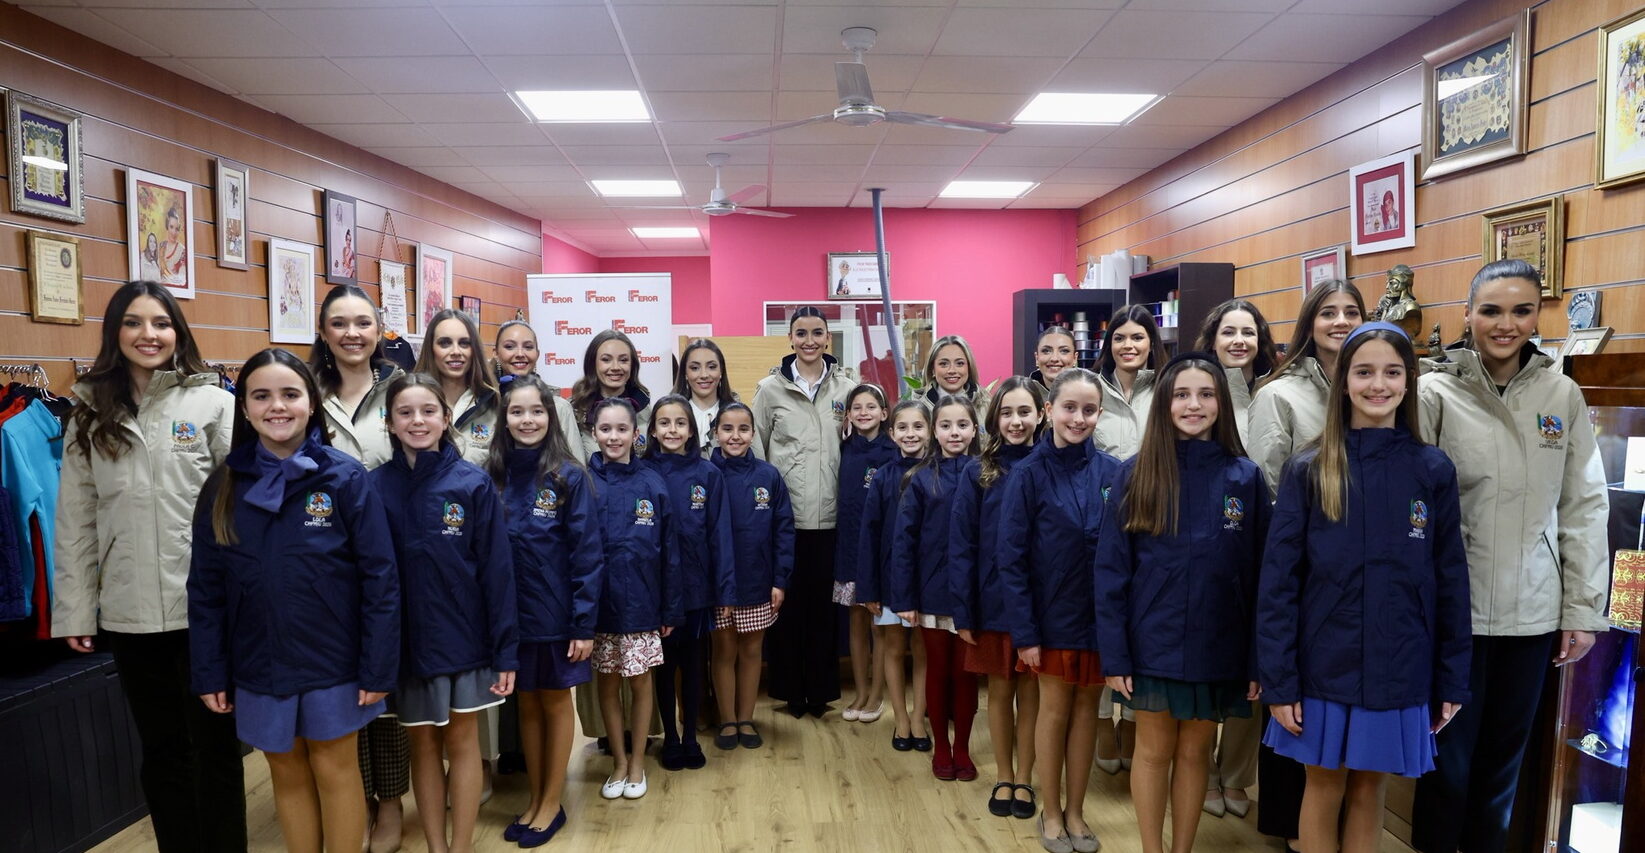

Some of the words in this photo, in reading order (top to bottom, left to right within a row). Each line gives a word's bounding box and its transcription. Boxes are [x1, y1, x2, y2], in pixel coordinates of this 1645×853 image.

[541, 290, 573, 303] FEROR
[585, 290, 616, 303] FEROR
[628, 289, 659, 302] FEROR
[555, 320, 592, 335] FEROR
[612, 319, 648, 334] FEROR
[545, 352, 575, 365] FEROR
